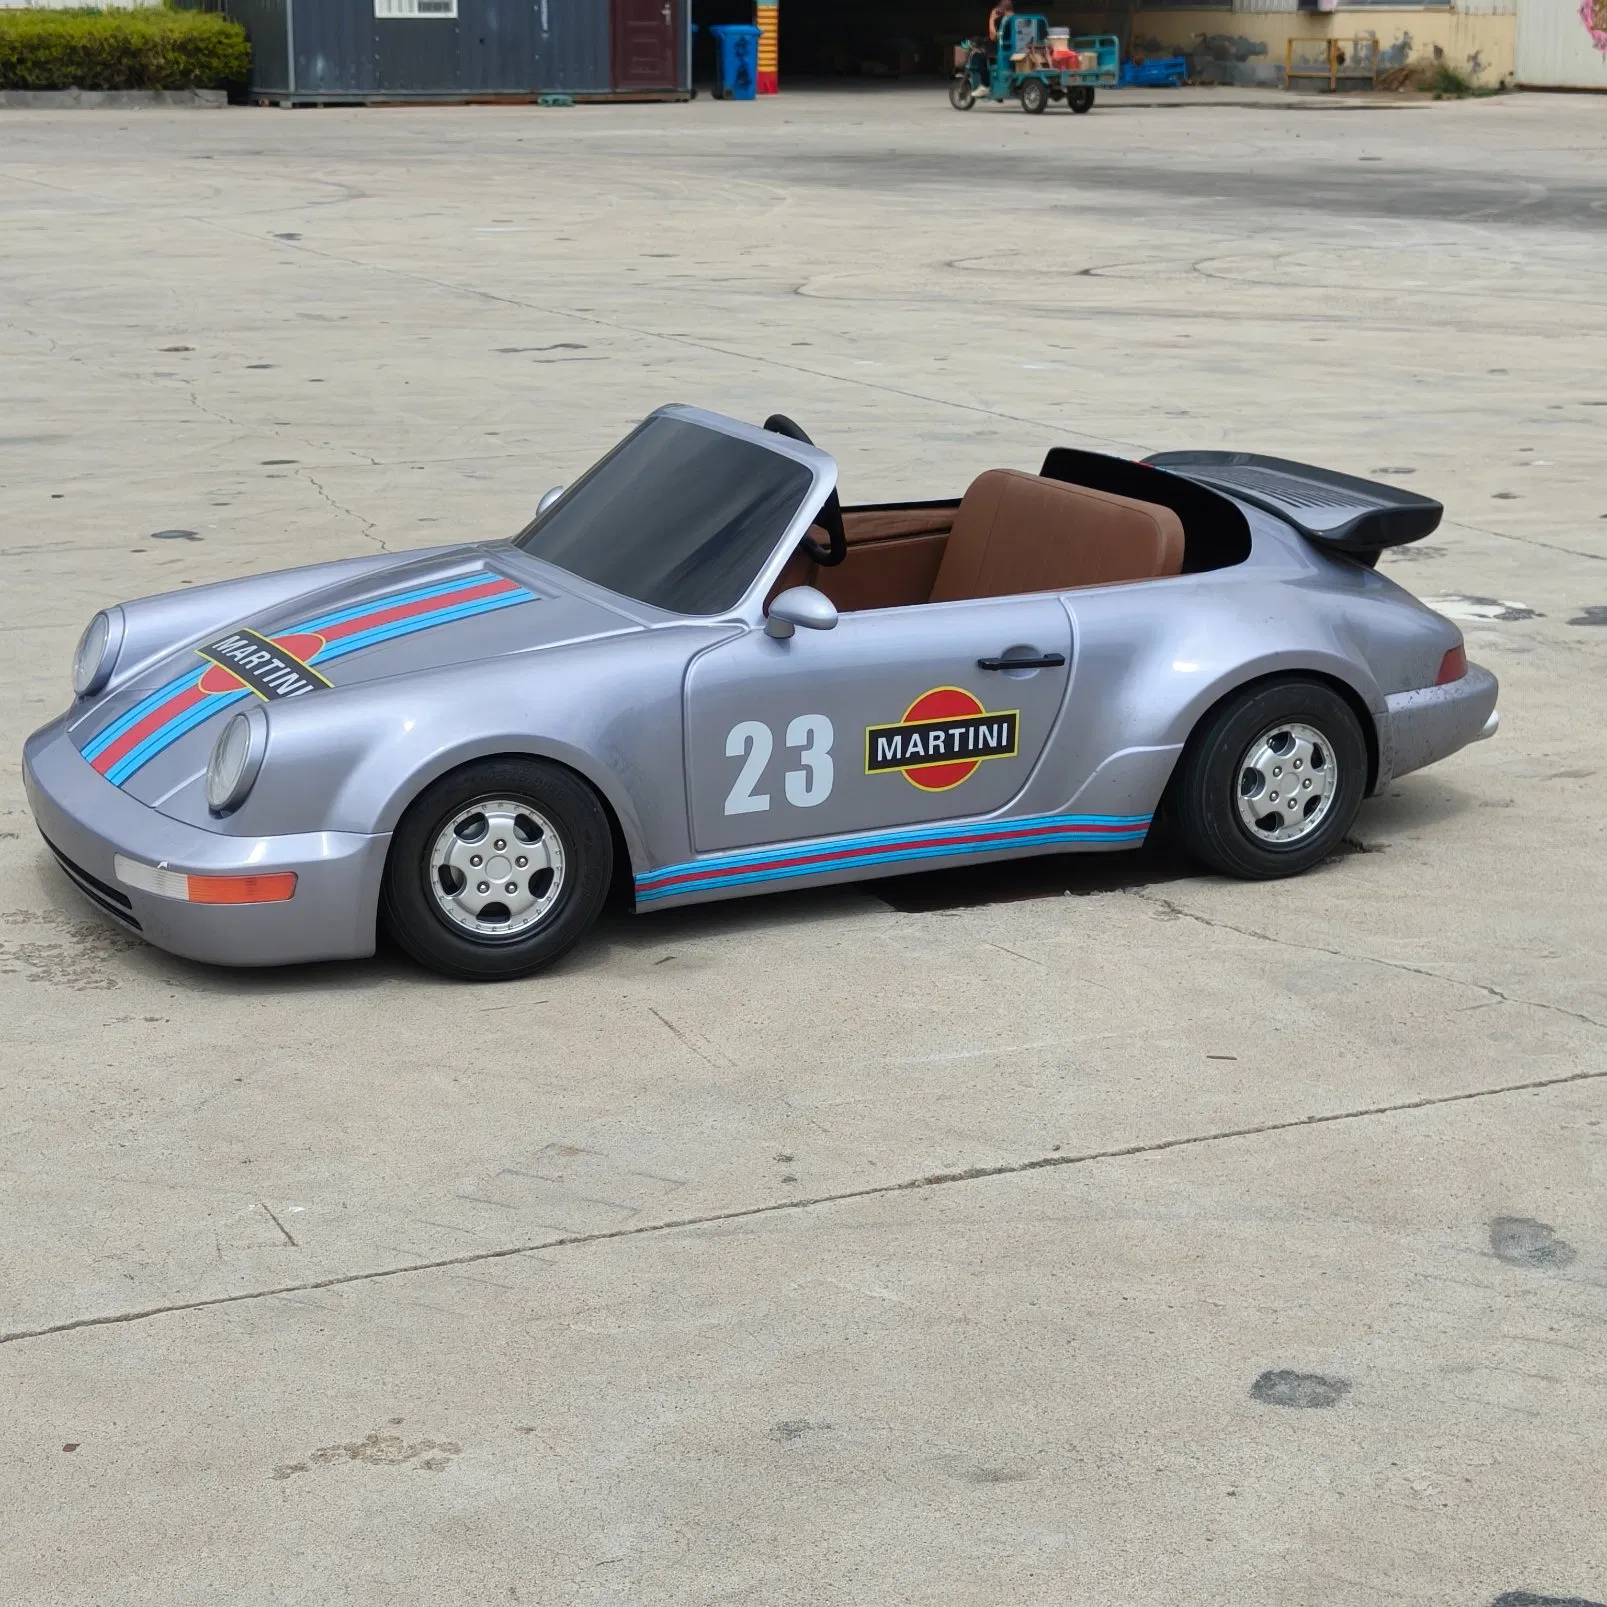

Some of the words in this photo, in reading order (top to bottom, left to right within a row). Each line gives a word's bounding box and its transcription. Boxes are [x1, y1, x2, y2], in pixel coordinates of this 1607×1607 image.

[212, 635, 314, 698] MARTINI
[724, 714, 834, 815] 23
[877, 723, 1008, 761] MARTINI
